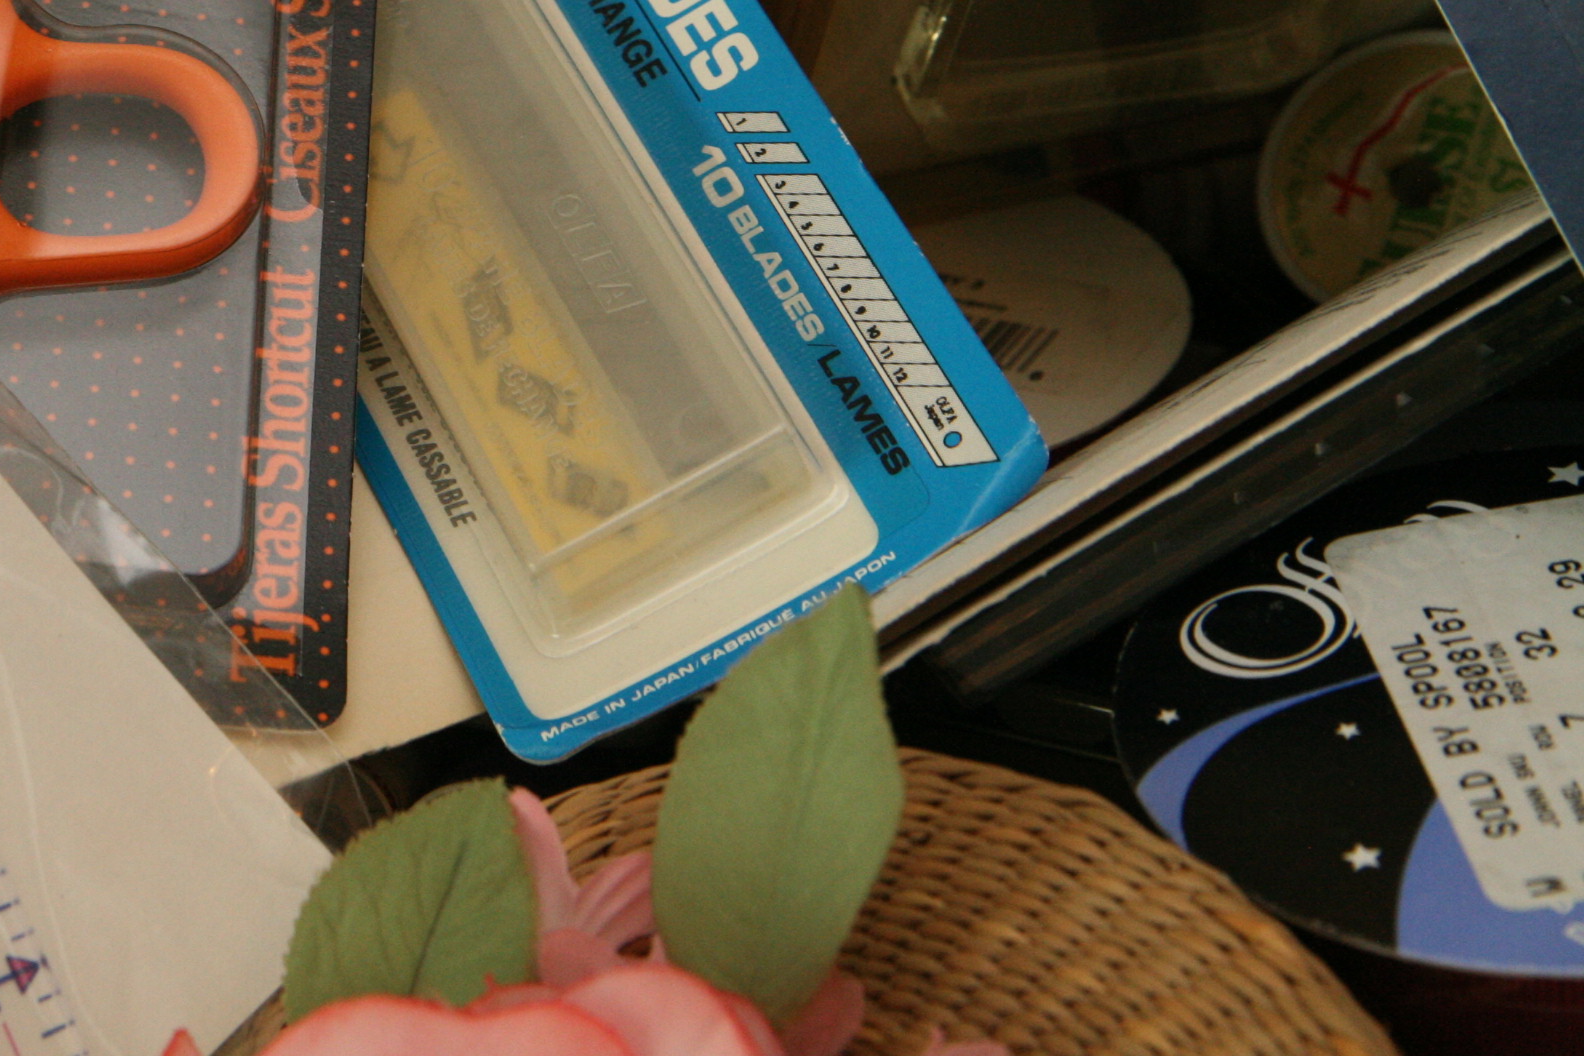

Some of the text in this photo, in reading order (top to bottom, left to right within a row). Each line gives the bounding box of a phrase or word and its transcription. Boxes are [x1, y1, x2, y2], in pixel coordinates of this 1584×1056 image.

[262, 25, 334, 223] Ciseaux
[691, 144, 745, 208] 10
[229, 265, 321, 683] Tijeras Shortcut
[375, 370, 423, 427] LAME
[406, 428, 477, 528] CASSABLE
[541, 710, 599, 743] MADE
[605, 698, 626, 715] IN
[800, 589, 829, 614] AU
[1422, 605, 1507, 711] 5808167
[1485, 642, 1531, 704] POSITION
[1515, 628, 1558, 660] 32
[1391, 633, 1520, 839] SOLD BY SPOOL
